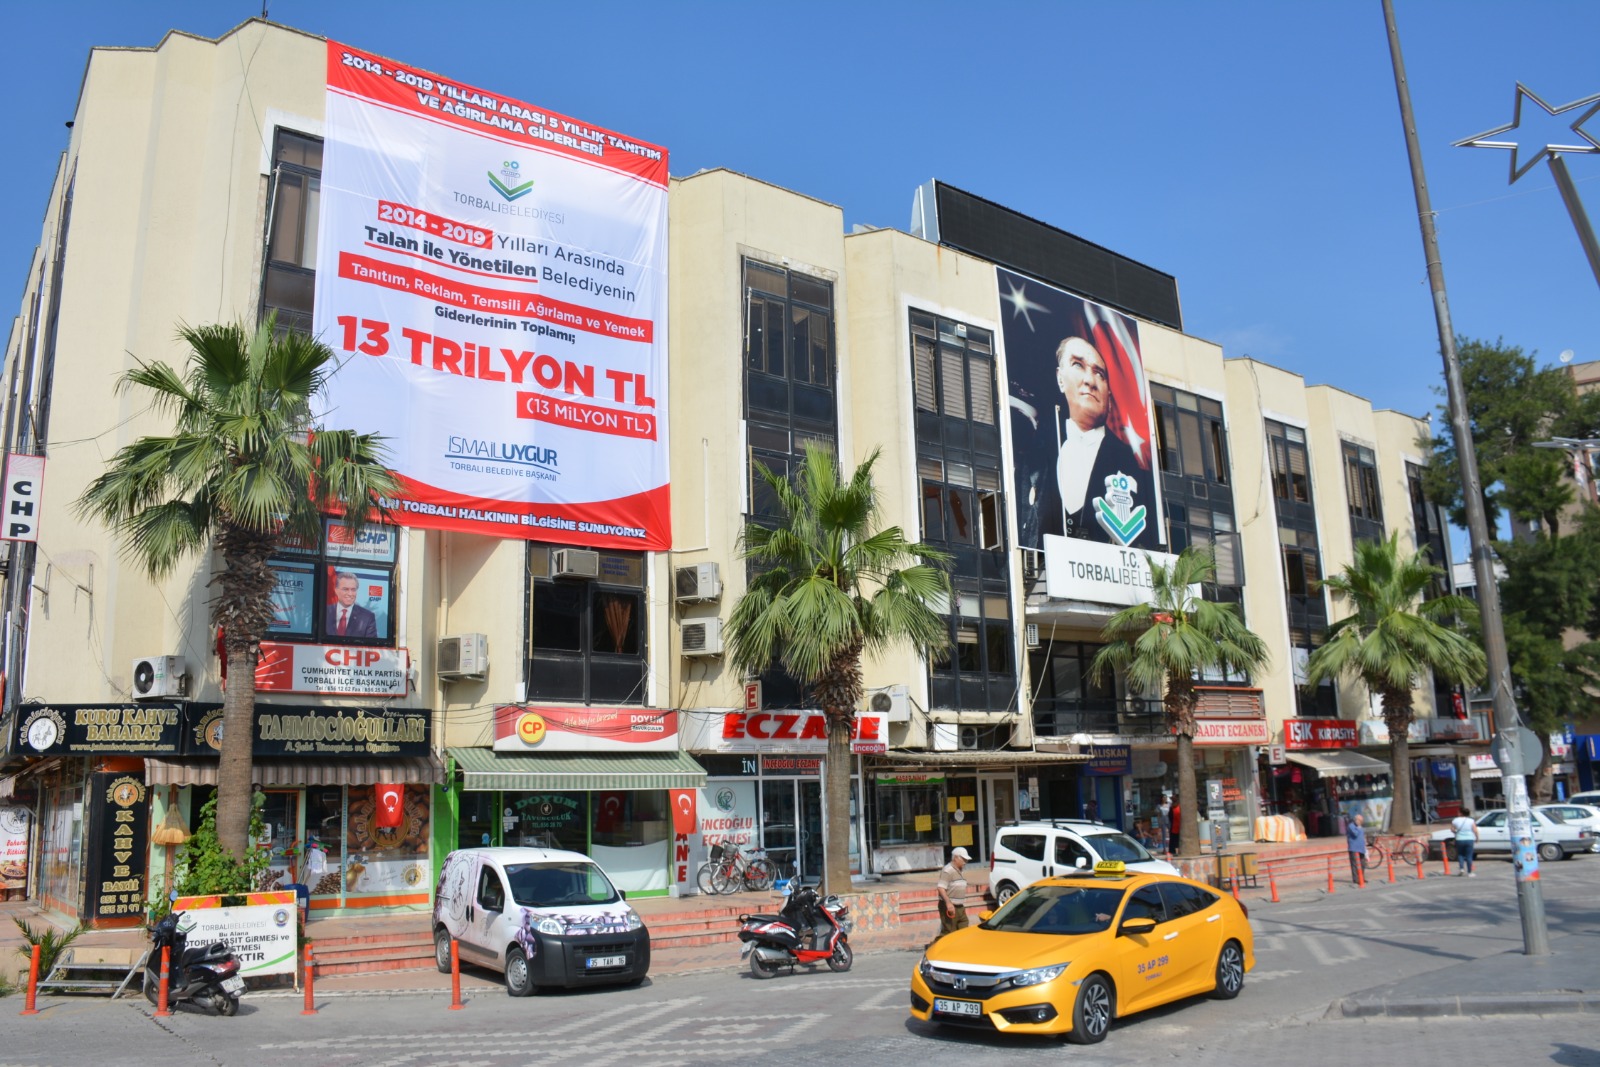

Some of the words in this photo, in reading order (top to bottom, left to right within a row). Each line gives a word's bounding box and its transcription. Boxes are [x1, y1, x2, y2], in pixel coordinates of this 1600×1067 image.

[342, 52, 382, 76] 2014
[395, 70, 434, 91] 2019
[436, 82, 498, 111] YILLARI
[500, 102, 546, 125] ARASI
[549, 116, 559, 128] 5
[561, 120, 606, 144] YILLIK
[607, 135, 662, 161] TANITIM
[417, 92, 440, 109] VE
[442, 101, 525, 134] AĞIRLAMA
[380, 204, 427, 230] 2014
[442, 222, 486, 245] 2019
[497, 234, 548, 256] Yılları
[554, 246, 625, 276] Arasında
[364, 226, 419, 252] Talan
[423, 240, 444, 260] ile
[448, 249, 537, 277] Yönetilen
[542, 266, 636, 302] Belediyenin
[351, 262, 410, 290] Tanıtım,
[414, 278, 467, 305] Reklam,
[471, 294, 521, 312] Temsili
[525, 302, 583, 325] Ağırlama
[586, 318, 600, 330] ve
[603, 320, 646, 338] Yemek
[434, 305, 517, 330] Giderlerinin
[520, 320, 576, 344] Toplamı;
[337, 315, 390, 356] 13
[606, 369, 656, 409] TL
[526, 397, 550, 415] (13
[622, 415, 652, 435] TL)
[450, 462, 484, 474] TORBALI
[486, 465, 524, 477] BELEDİYE
[526, 470, 557, 482] BAŞKANI
[9, 481, 34, 537] CHP
[402, 500, 456, 518] TORBALI
[458, 508, 519, 524] HALKININ
[521, 513, 576, 531] BİLGİSİNE
[578, 522, 646, 538] SUNUYORUZ
[356, 530, 388, 545] CHP
[1119, 550, 1140, 569] T.C.
[1068, 561, 1152, 588] TORBALIBELE
[324, 648, 381, 668] CHP
[302, 667, 352, 676] CUMHURİYET
[354, 669, 374, 677] HALK
[304, 676, 336, 684] TORBALI
[338, 677, 355, 686] İLÇE
[356, 679, 400, 687] BAŞKANLIĞI
[746, 687, 756, 708] E
[74, 708, 121, 726] KURU
[122, 708, 178, 726] KAHVE
[258, 710, 426, 742] TAHMİSCİOĞULLARI
[631, 714, 664, 724] DOYUM
[722, 713, 881, 740] ECZAE
[86, 724, 164, 741] BAHARAT
[522, 722, 542, 734] CP
[1198, 724, 1226, 737] AADET
[1290, 722, 1314, 742] IŞIK
[854, 744, 886, 753] inceoğlu
[1273, 748, 1280, 760] E
[796, 758, 820, 769] ECZANE
[515, 795, 579, 810] DOYUM
[113, 810, 135, 877] KAHVE
[184, 939, 218, 948] OTORLU
[590, 958, 598, 968] 35
[602, 958, 614, 967] TAH
[1138, 962, 1146, 974] 35
[1147, 959, 1156, 970] AP
[1157, 955, 1169, 967] 299
[939, 1001, 948, 1011] 35
[952, 1002, 960, 1012] AP
[964, 1003, 979, 1014] 299
